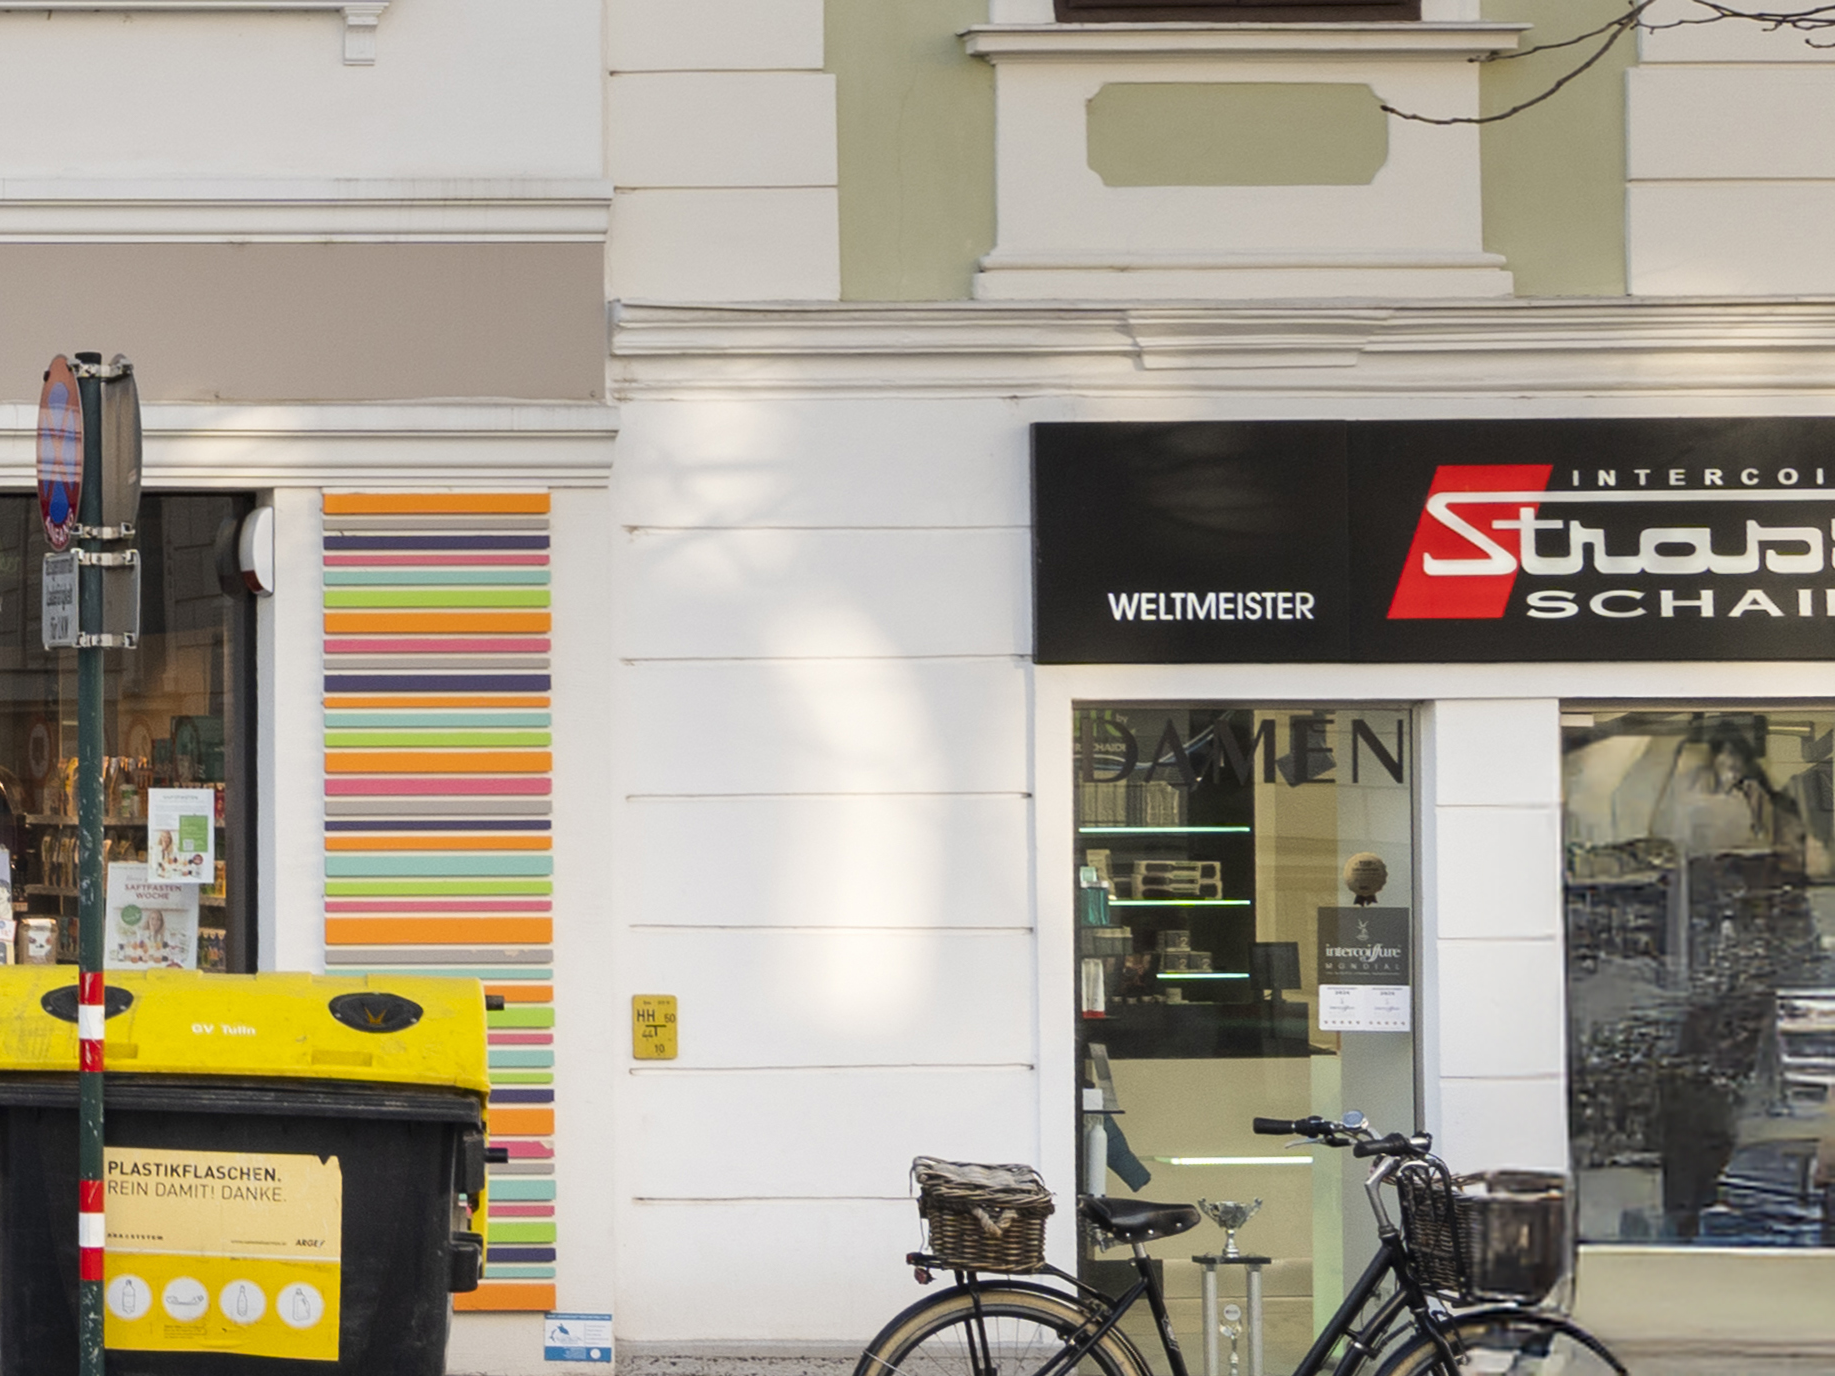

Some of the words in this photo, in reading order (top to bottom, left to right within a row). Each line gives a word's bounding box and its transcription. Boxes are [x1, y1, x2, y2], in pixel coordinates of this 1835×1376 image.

[1108, 591, 1315, 621] WELTMEISTER
[1083, 718, 1404, 785] DAMEN
[124, 883, 182, 892] SAFTFASTEN
[135, 892, 170, 900] WOCHE
[1325, 943, 1402, 963] intercoiffure
[636, 1008, 656, 1023] HH
[191, 1024, 215, 1035] GV
[222, 1024, 256, 1036] Tulln
[108, 1160, 282, 1183] PLASTIKFLASCHEN.
[107, 1180, 149, 1196] REIN
[154, 1183, 215, 1199] DAMIT!
[221, 1185, 287, 1202] DANKE.
